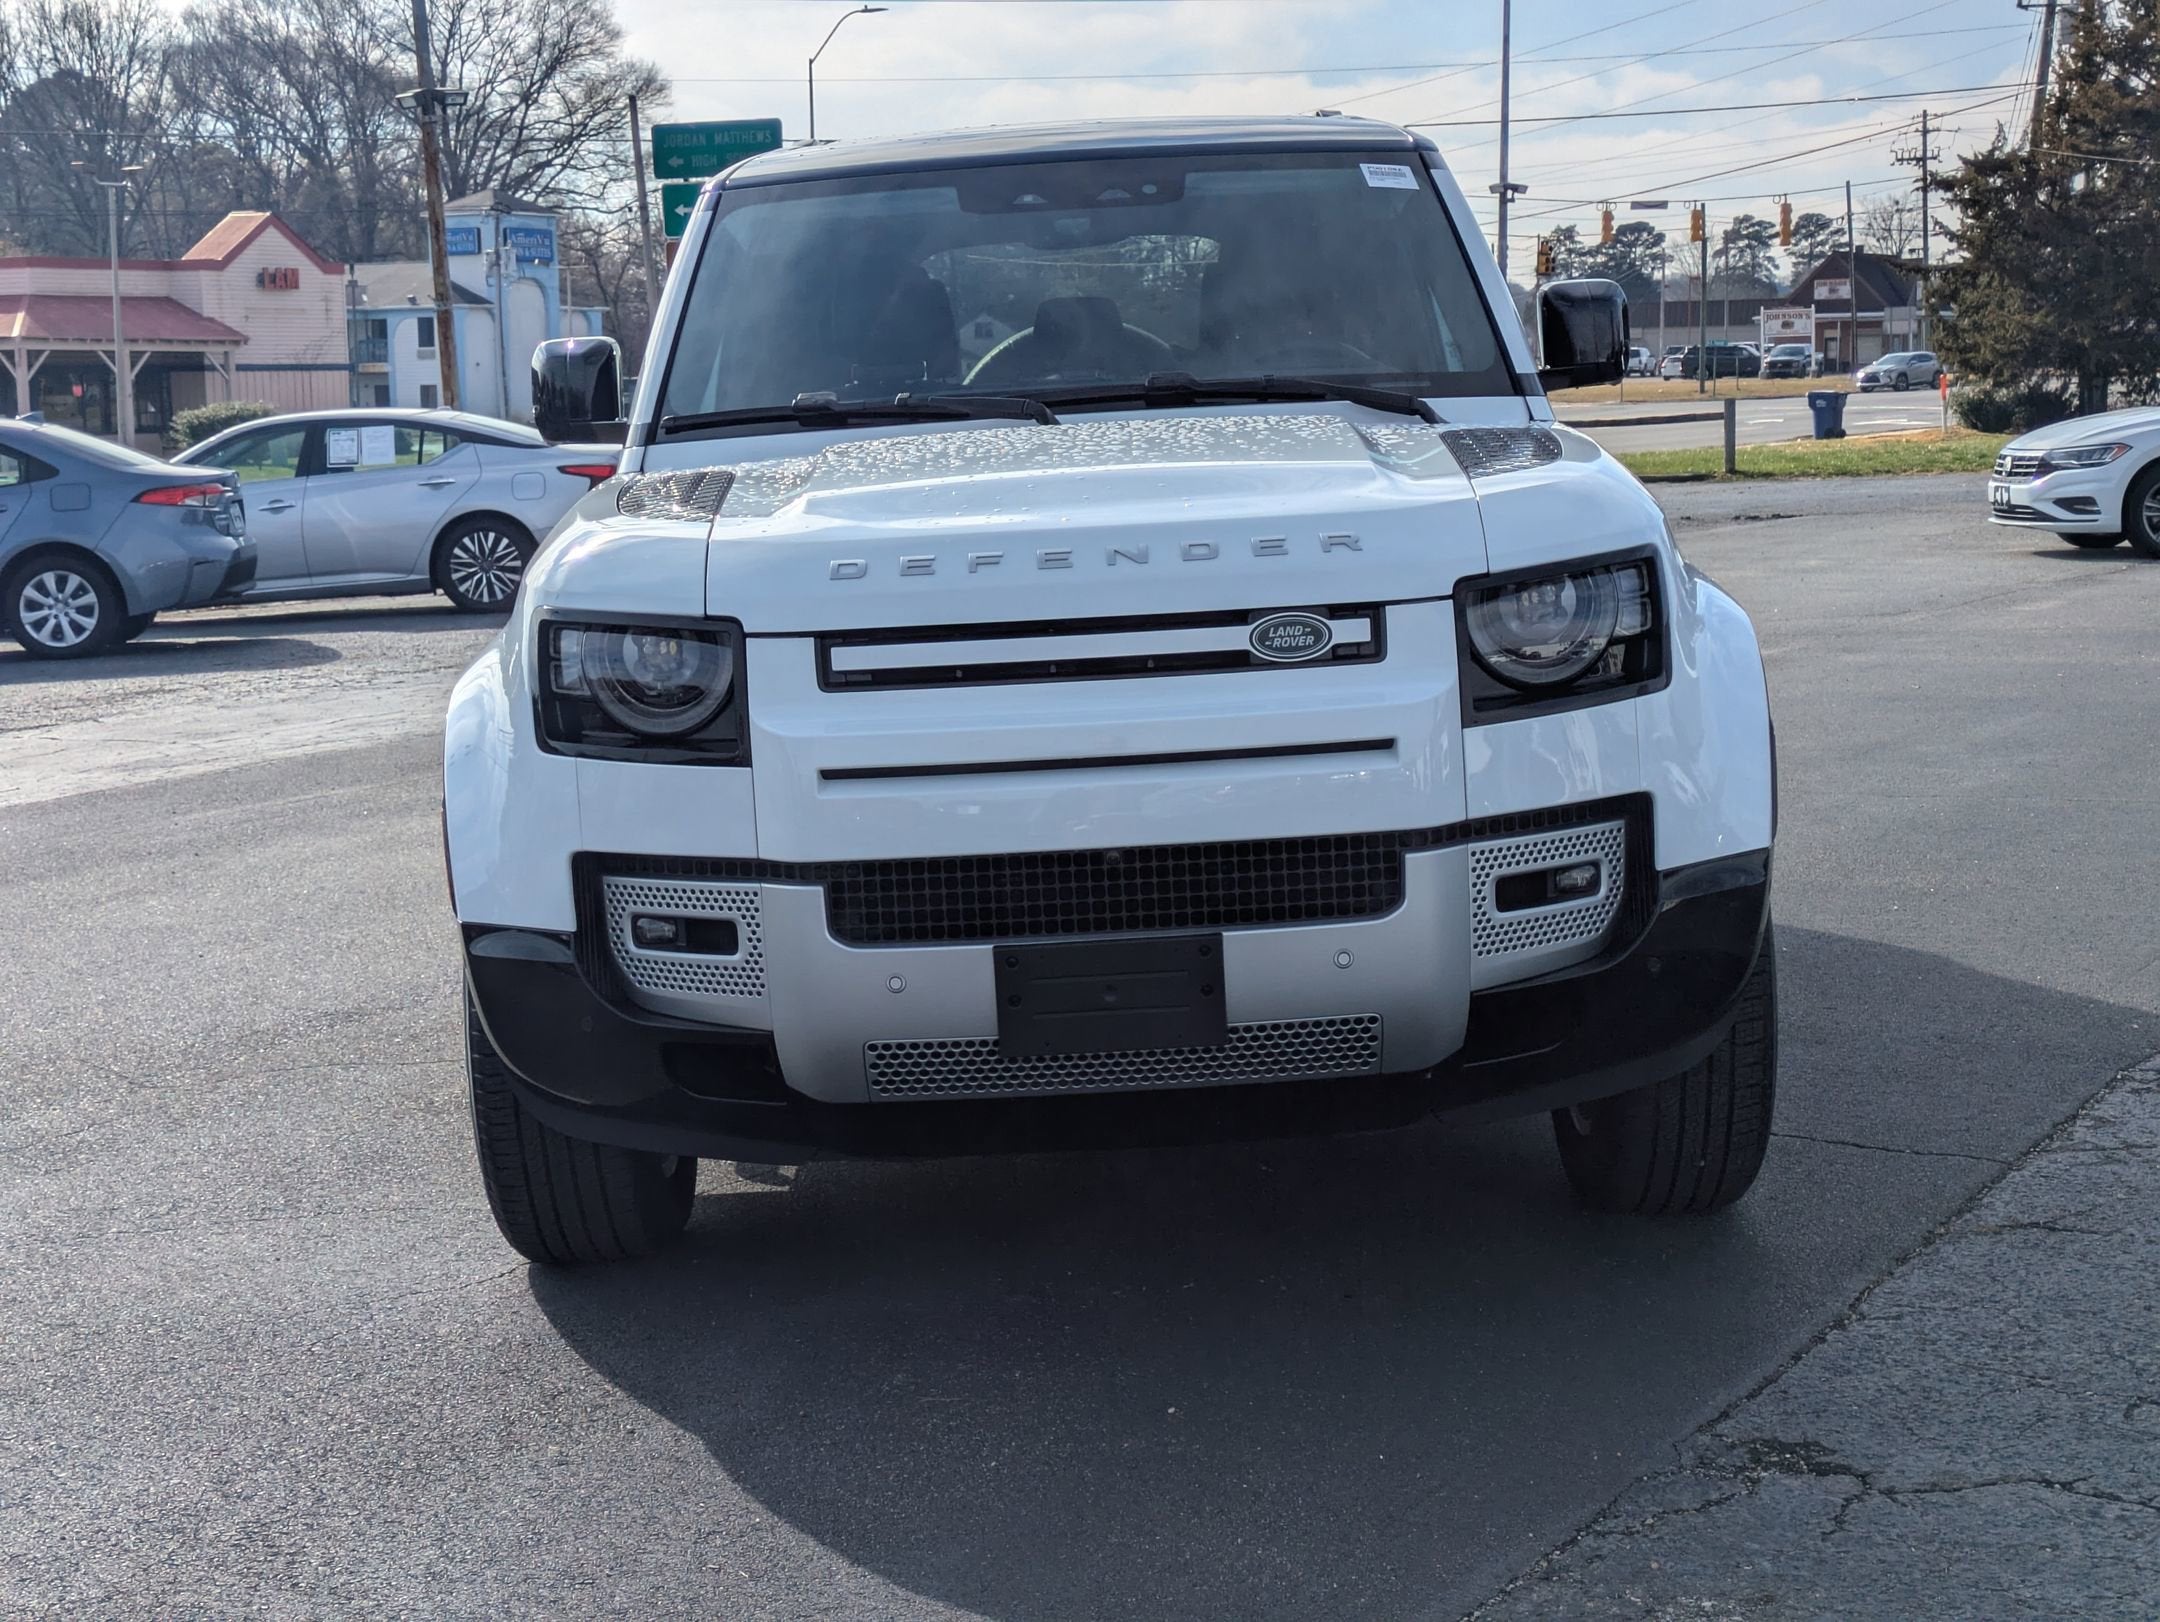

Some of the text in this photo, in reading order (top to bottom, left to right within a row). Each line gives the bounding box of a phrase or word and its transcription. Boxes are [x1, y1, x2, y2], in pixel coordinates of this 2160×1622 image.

[664, 130, 772, 148] JORDAN MATTHEWS
[691, 154, 717, 168] HIGH
[1766, 312, 1811, 323] JOHNSON'S
[829, 531, 1362, 580] DEFENDER
